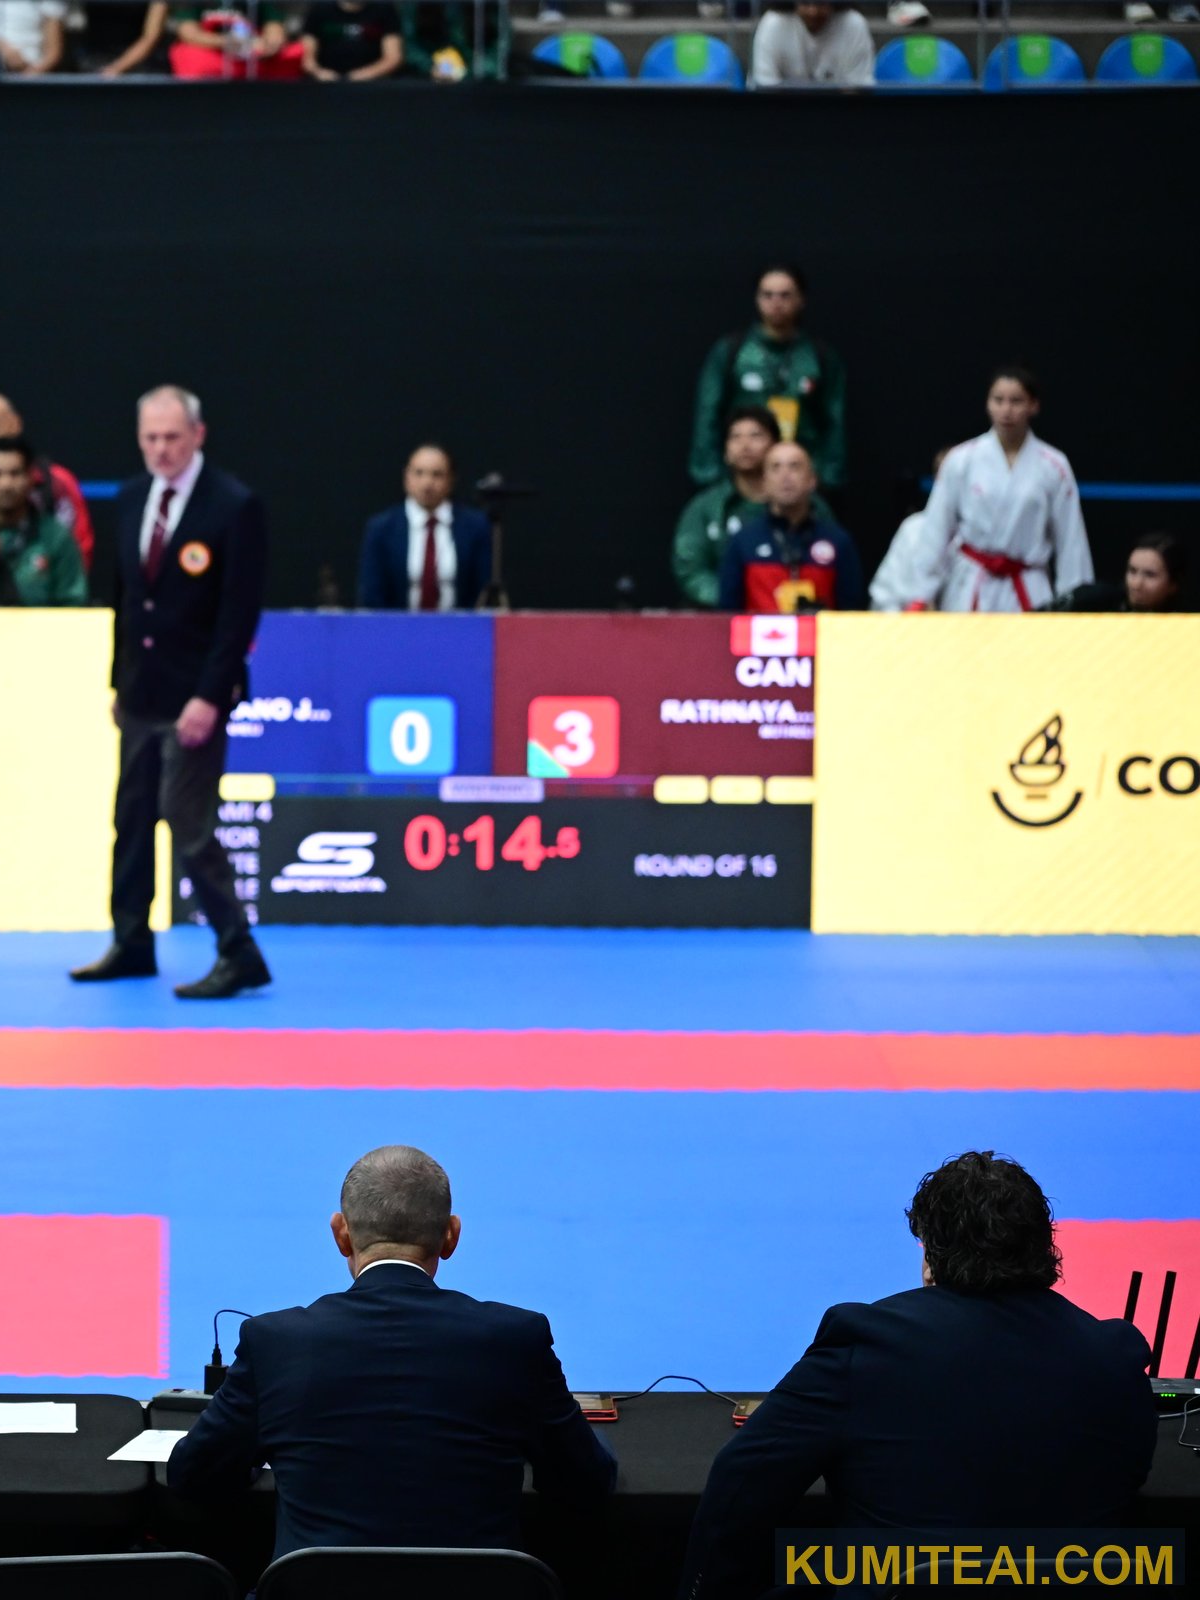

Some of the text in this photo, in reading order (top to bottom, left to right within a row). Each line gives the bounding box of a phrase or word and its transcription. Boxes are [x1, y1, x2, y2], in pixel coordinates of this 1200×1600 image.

[736, 656, 812, 687] CAN
[390, 710, 431, 765] 0
[553, 710, 595, 766] 3
[634, 854, 778, 877] ROUND OF 16
